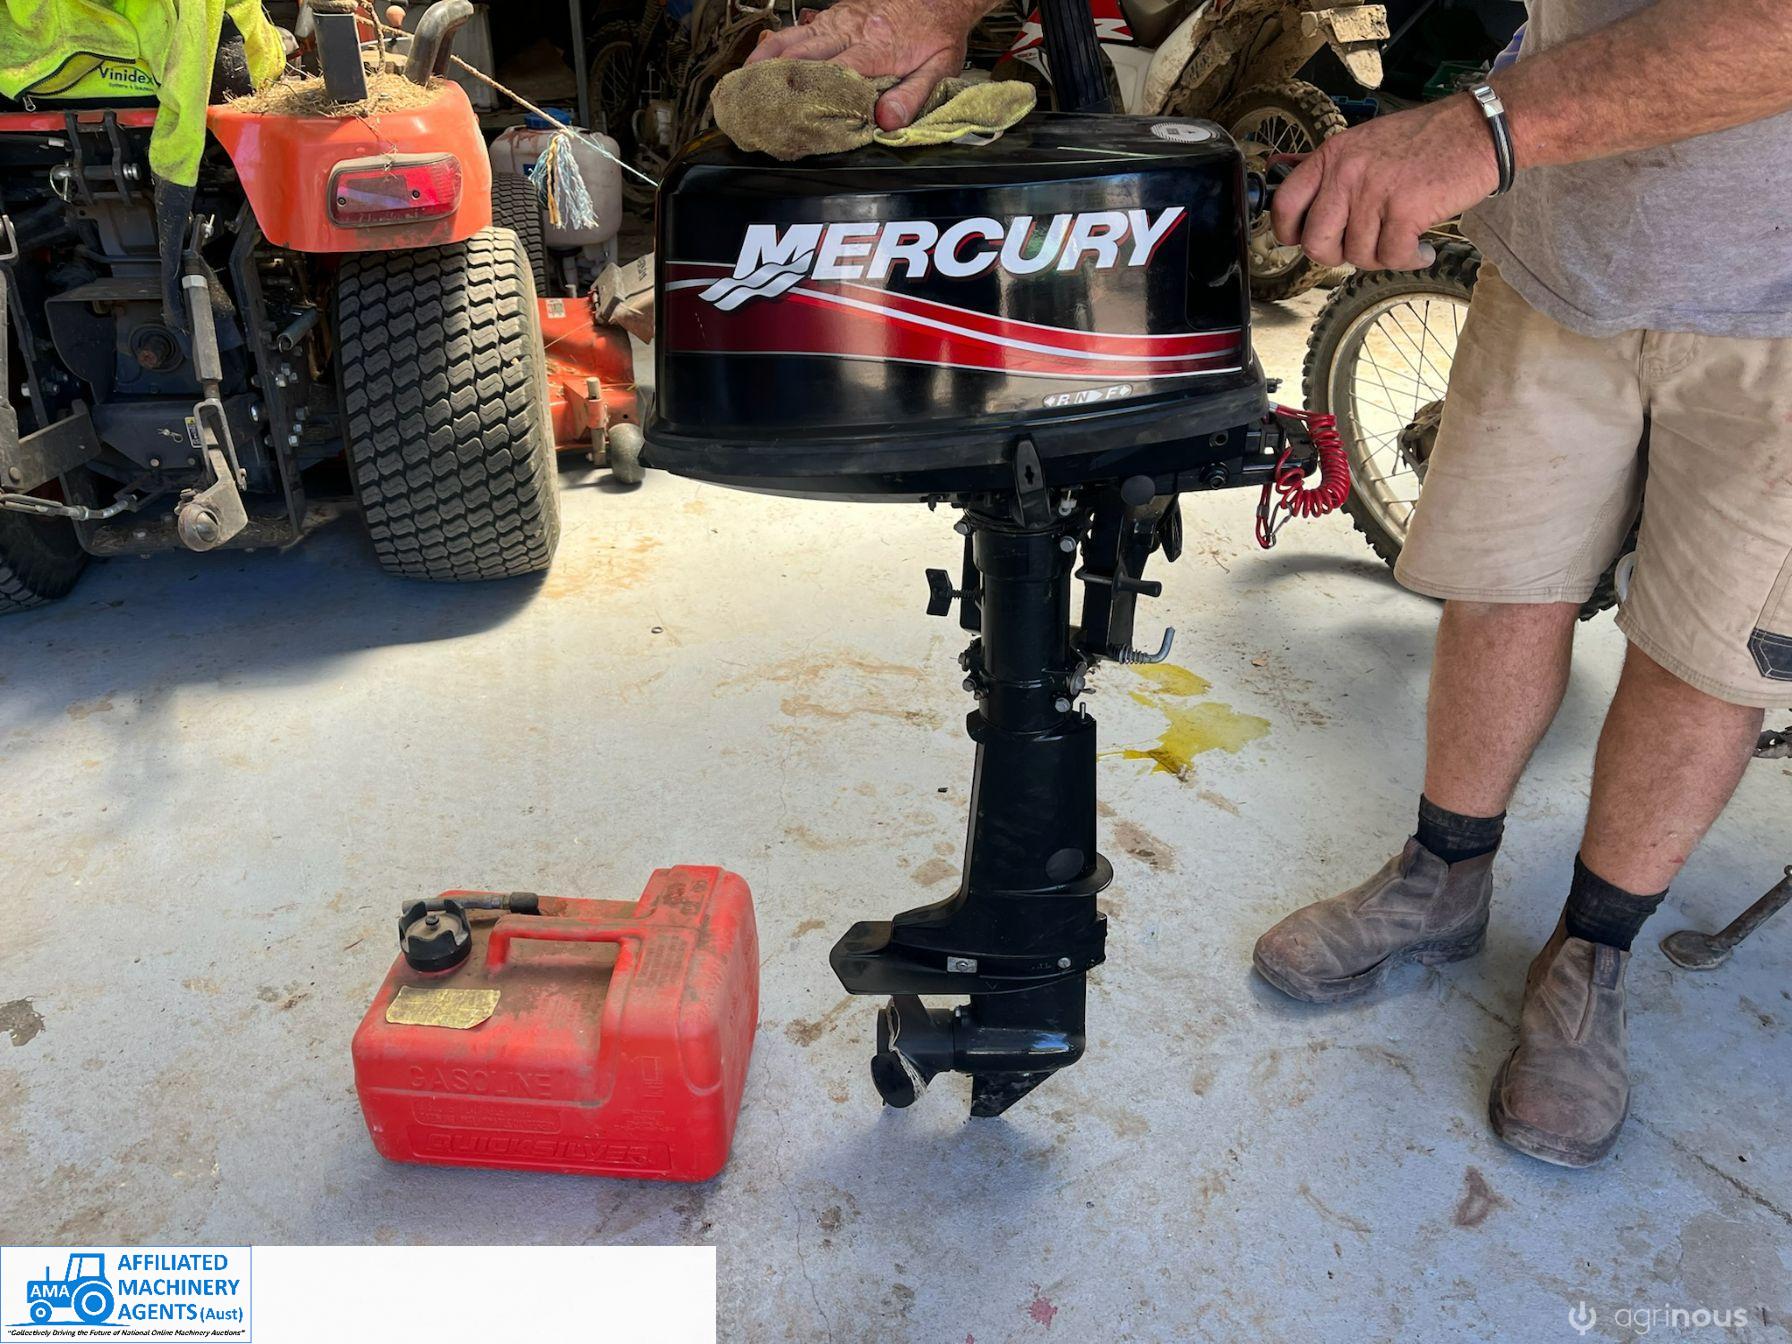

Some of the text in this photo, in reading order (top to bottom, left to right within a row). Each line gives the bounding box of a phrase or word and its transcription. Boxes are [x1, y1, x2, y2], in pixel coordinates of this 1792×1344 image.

[100, 66, 154, 85] Vinidex
[714, 206, 1187, 292] MERCURY
[407, 1064, 552, 1097] GASOLINE
